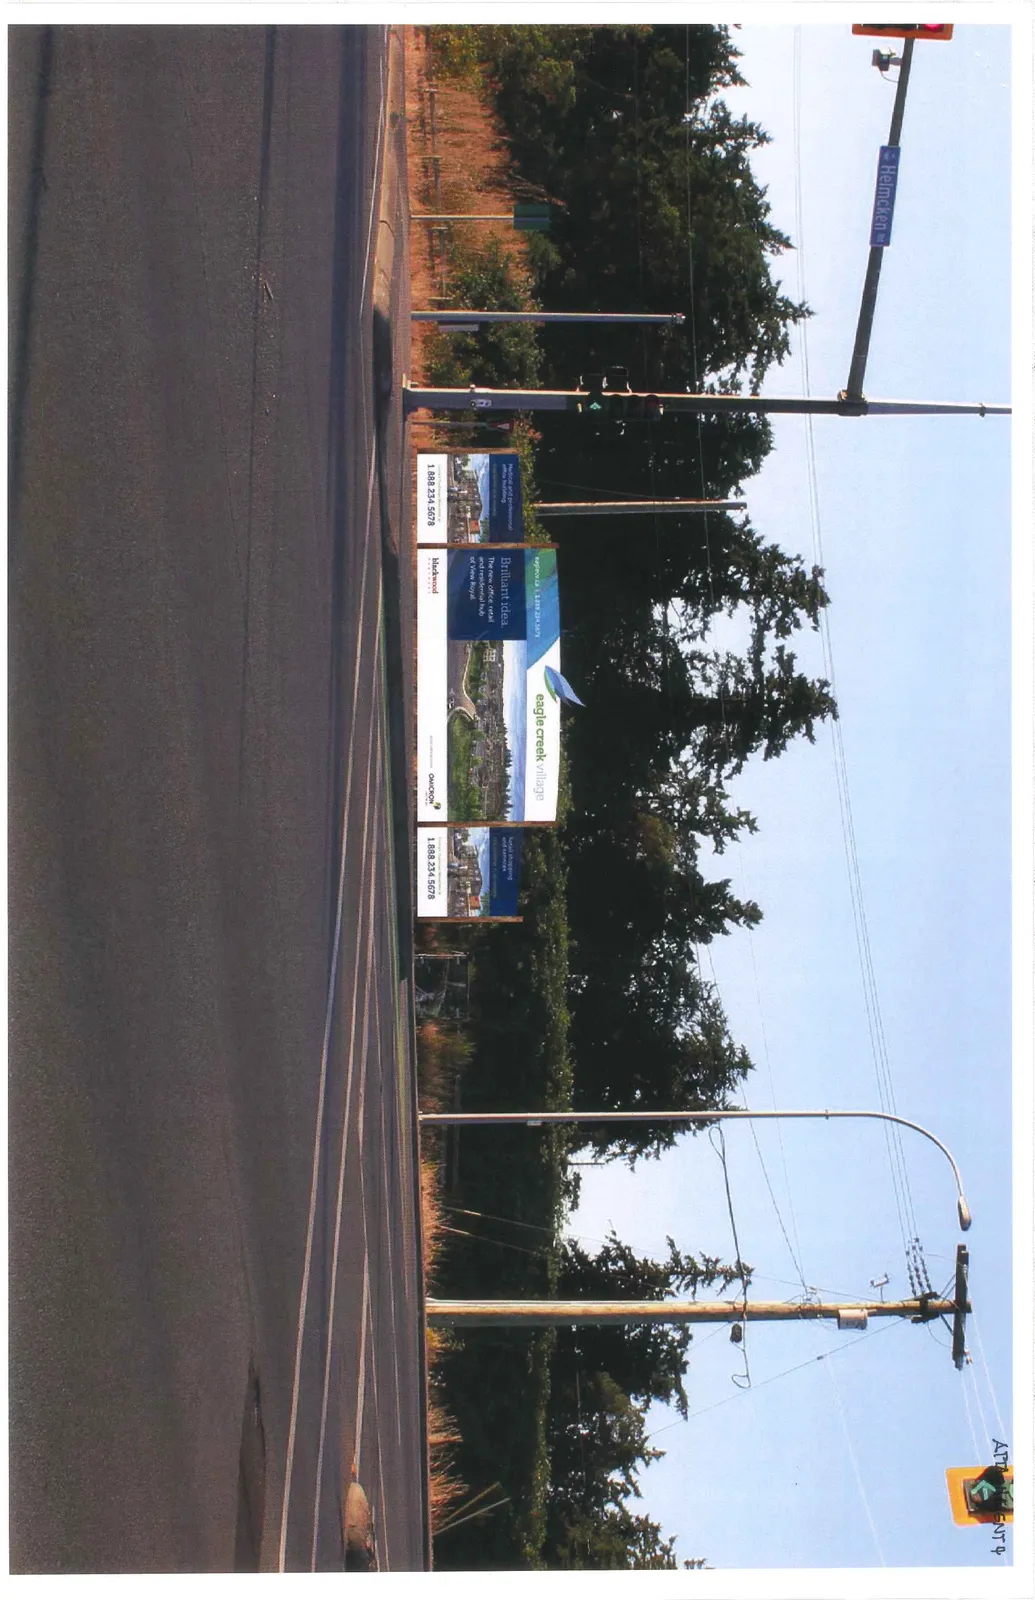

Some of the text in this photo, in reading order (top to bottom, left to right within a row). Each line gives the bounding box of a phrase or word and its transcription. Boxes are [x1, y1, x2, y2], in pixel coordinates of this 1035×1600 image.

[874, 165, 896, 230] Helmcken
[427, 464, 435, 527] 1.888.234.5678
[470, 556, 476, 564] of
[500, 556, 512, 629] Brilliant idea.
[533, 694, 546, 802] eagle creek village
[427, 837, 435, 900] 1.888.234.5678
